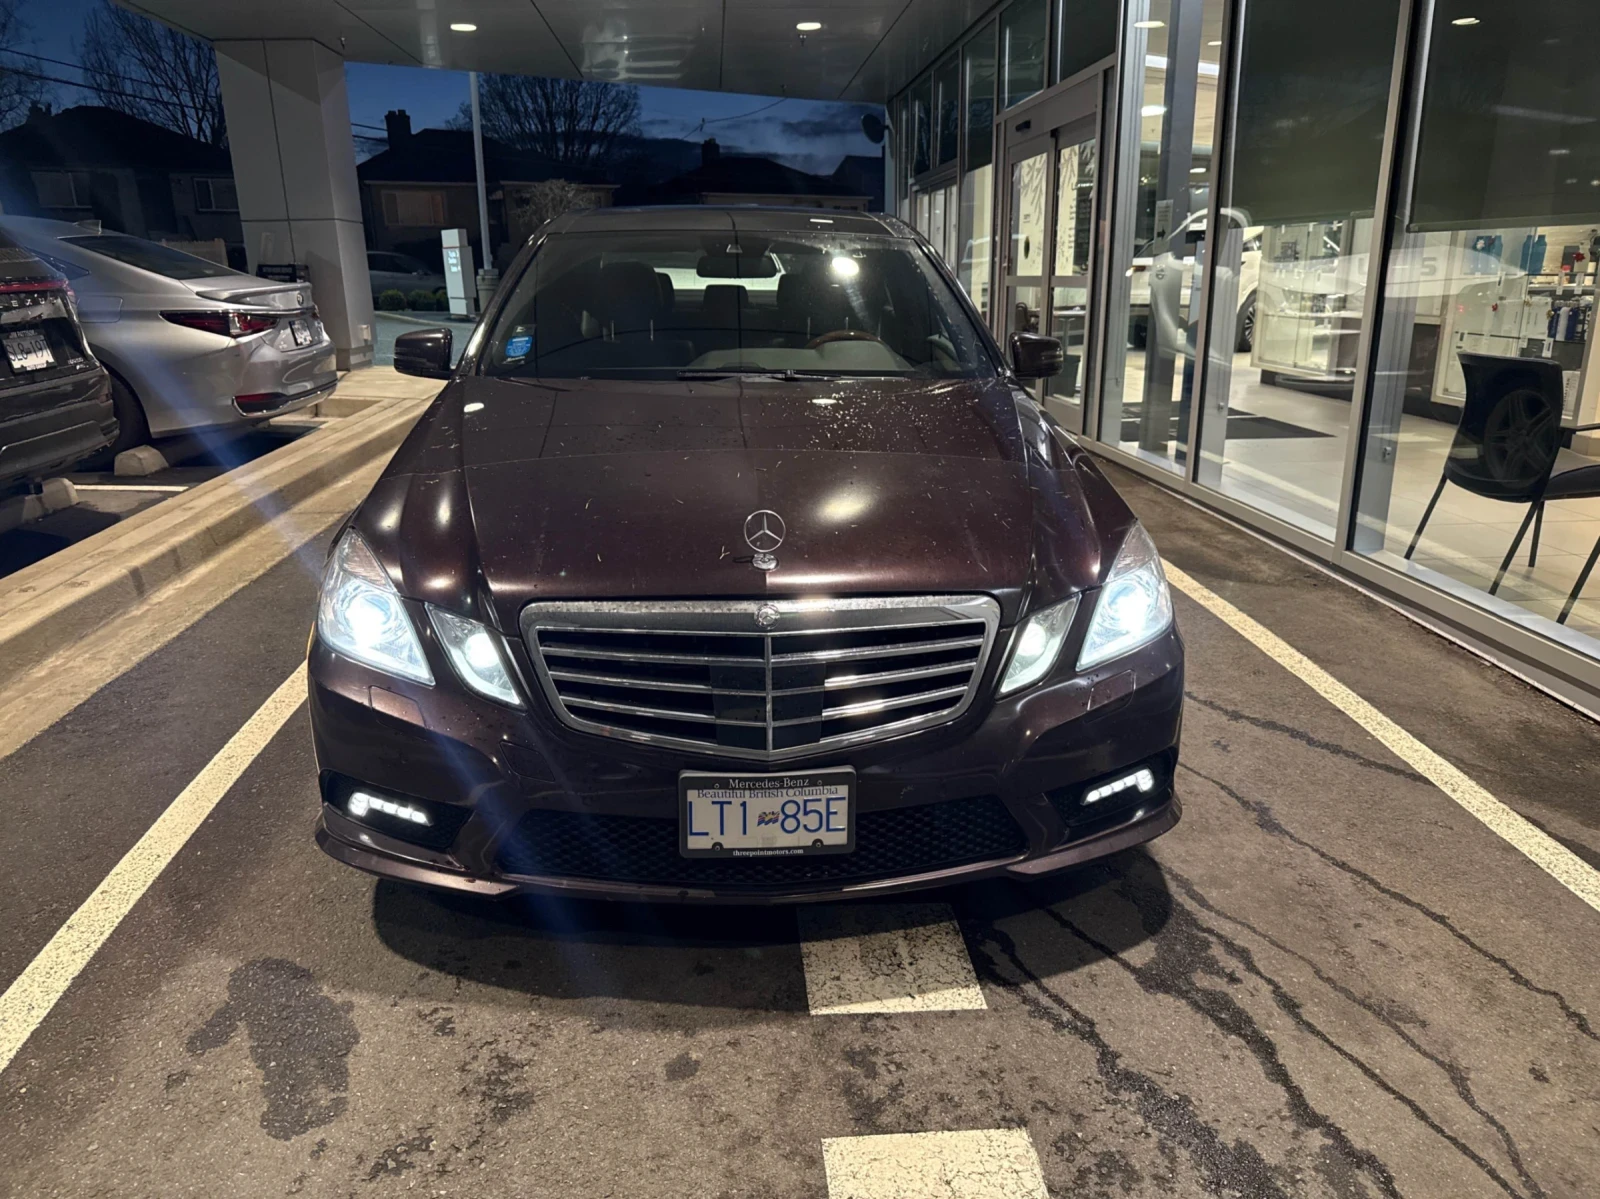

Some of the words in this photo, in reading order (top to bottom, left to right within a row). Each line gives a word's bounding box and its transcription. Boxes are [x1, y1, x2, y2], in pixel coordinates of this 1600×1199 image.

[728, 777, 810, 789] Mercedes-Benz
[697, 788, 746, 799] Beautiful
[749, 787, 784, 799] British
[785, 785, 839, 797] Columbia
[688, 800, 748, 836] LT1
[780, 796, 847, 834] 85E
[732, 848, 805, 857] threepointmotors.com
